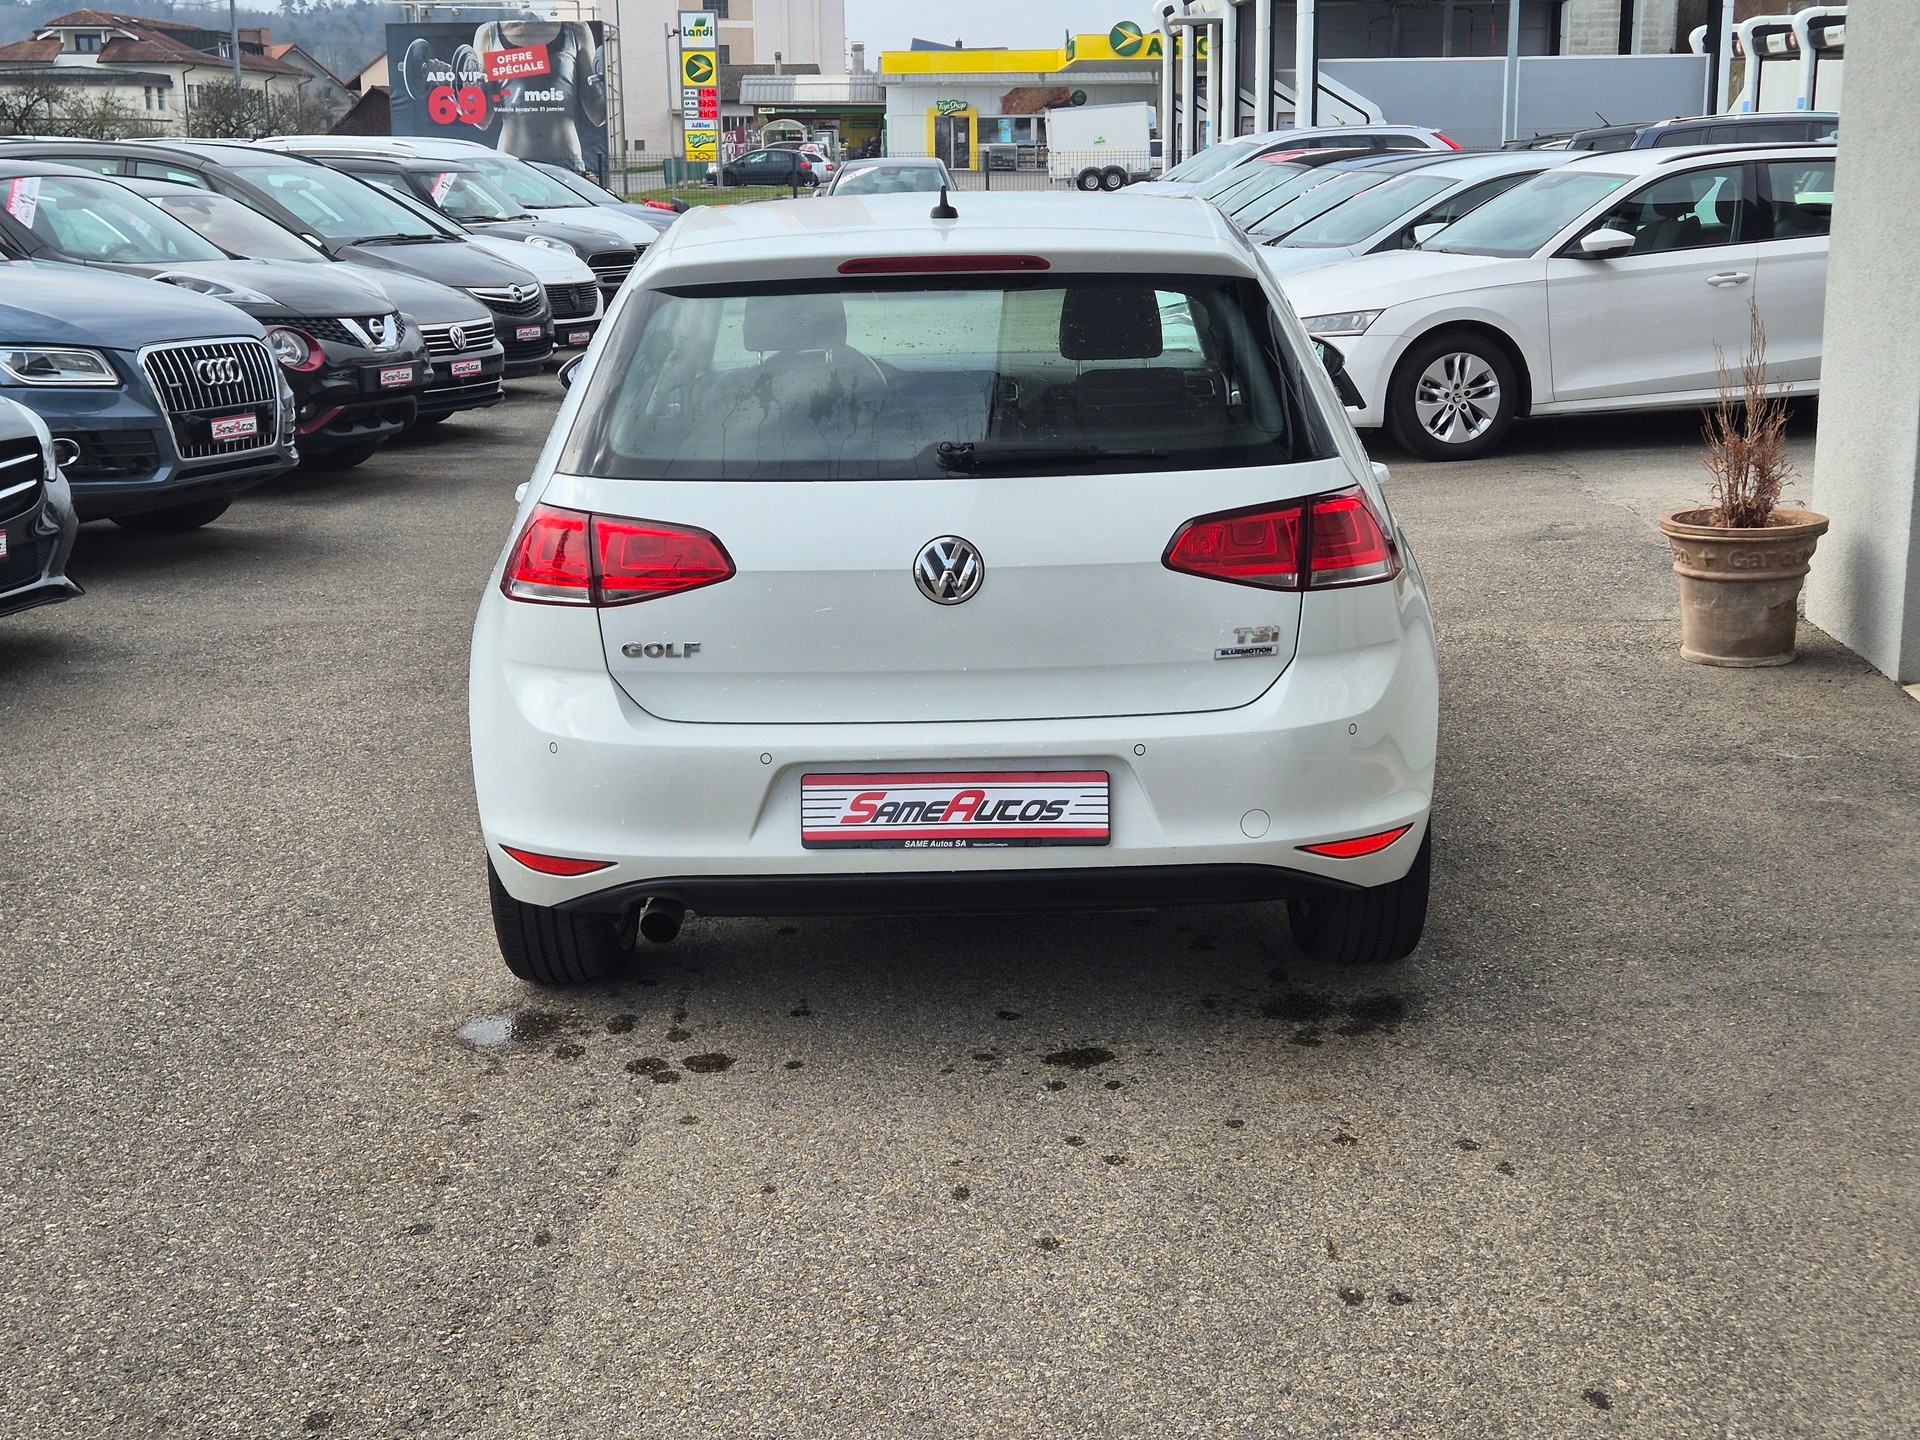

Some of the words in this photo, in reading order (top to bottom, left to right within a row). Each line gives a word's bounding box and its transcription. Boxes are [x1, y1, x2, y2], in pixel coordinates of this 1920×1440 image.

[683, 26, 713, 37] Landi
[497, 51, 533, 65] OFFRE
[492, 60, 545, 77] SPÉCIALE
[426, 71, 456, 82] ABO
[458, 71, 481, 82] VIP
[524, 87, 565, 102] mois
[621, 641, 701, 659] GOLF
[1220, 646, 1273, 656] BLUEMOTION
[904, 840, 929, 848] SAME
[929, 839, 954, 848] Autos
[954, 839, 967, 847] SA
